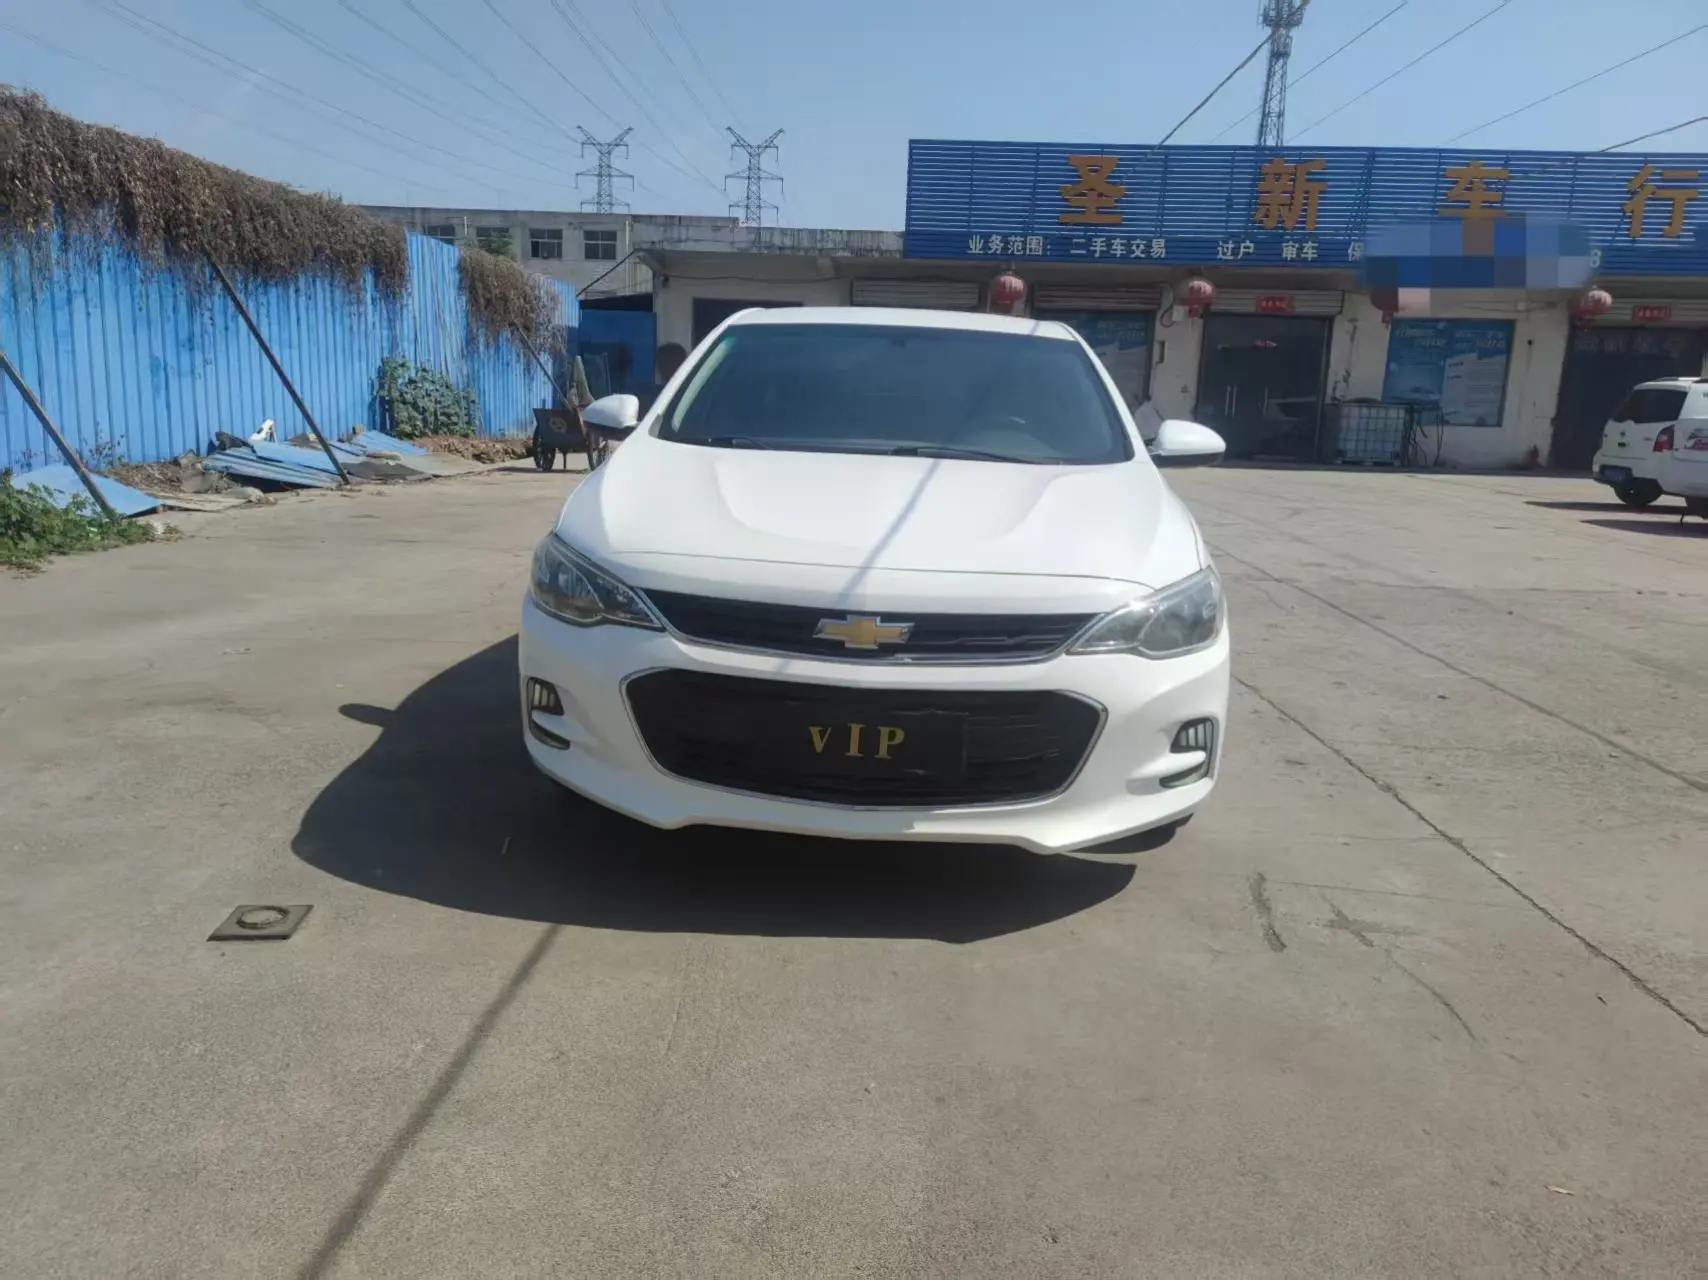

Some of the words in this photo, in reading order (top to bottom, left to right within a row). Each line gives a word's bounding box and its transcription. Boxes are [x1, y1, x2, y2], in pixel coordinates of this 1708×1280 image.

[1059, 154, 1699, 240] 圣新车行
[1069, 237, 1166, 258] 二手车交易
[1216, 240, 1255, 260] 过户
[1282, 240, 1318, 261] 审车
[808, 722, 906, 759] VIP
